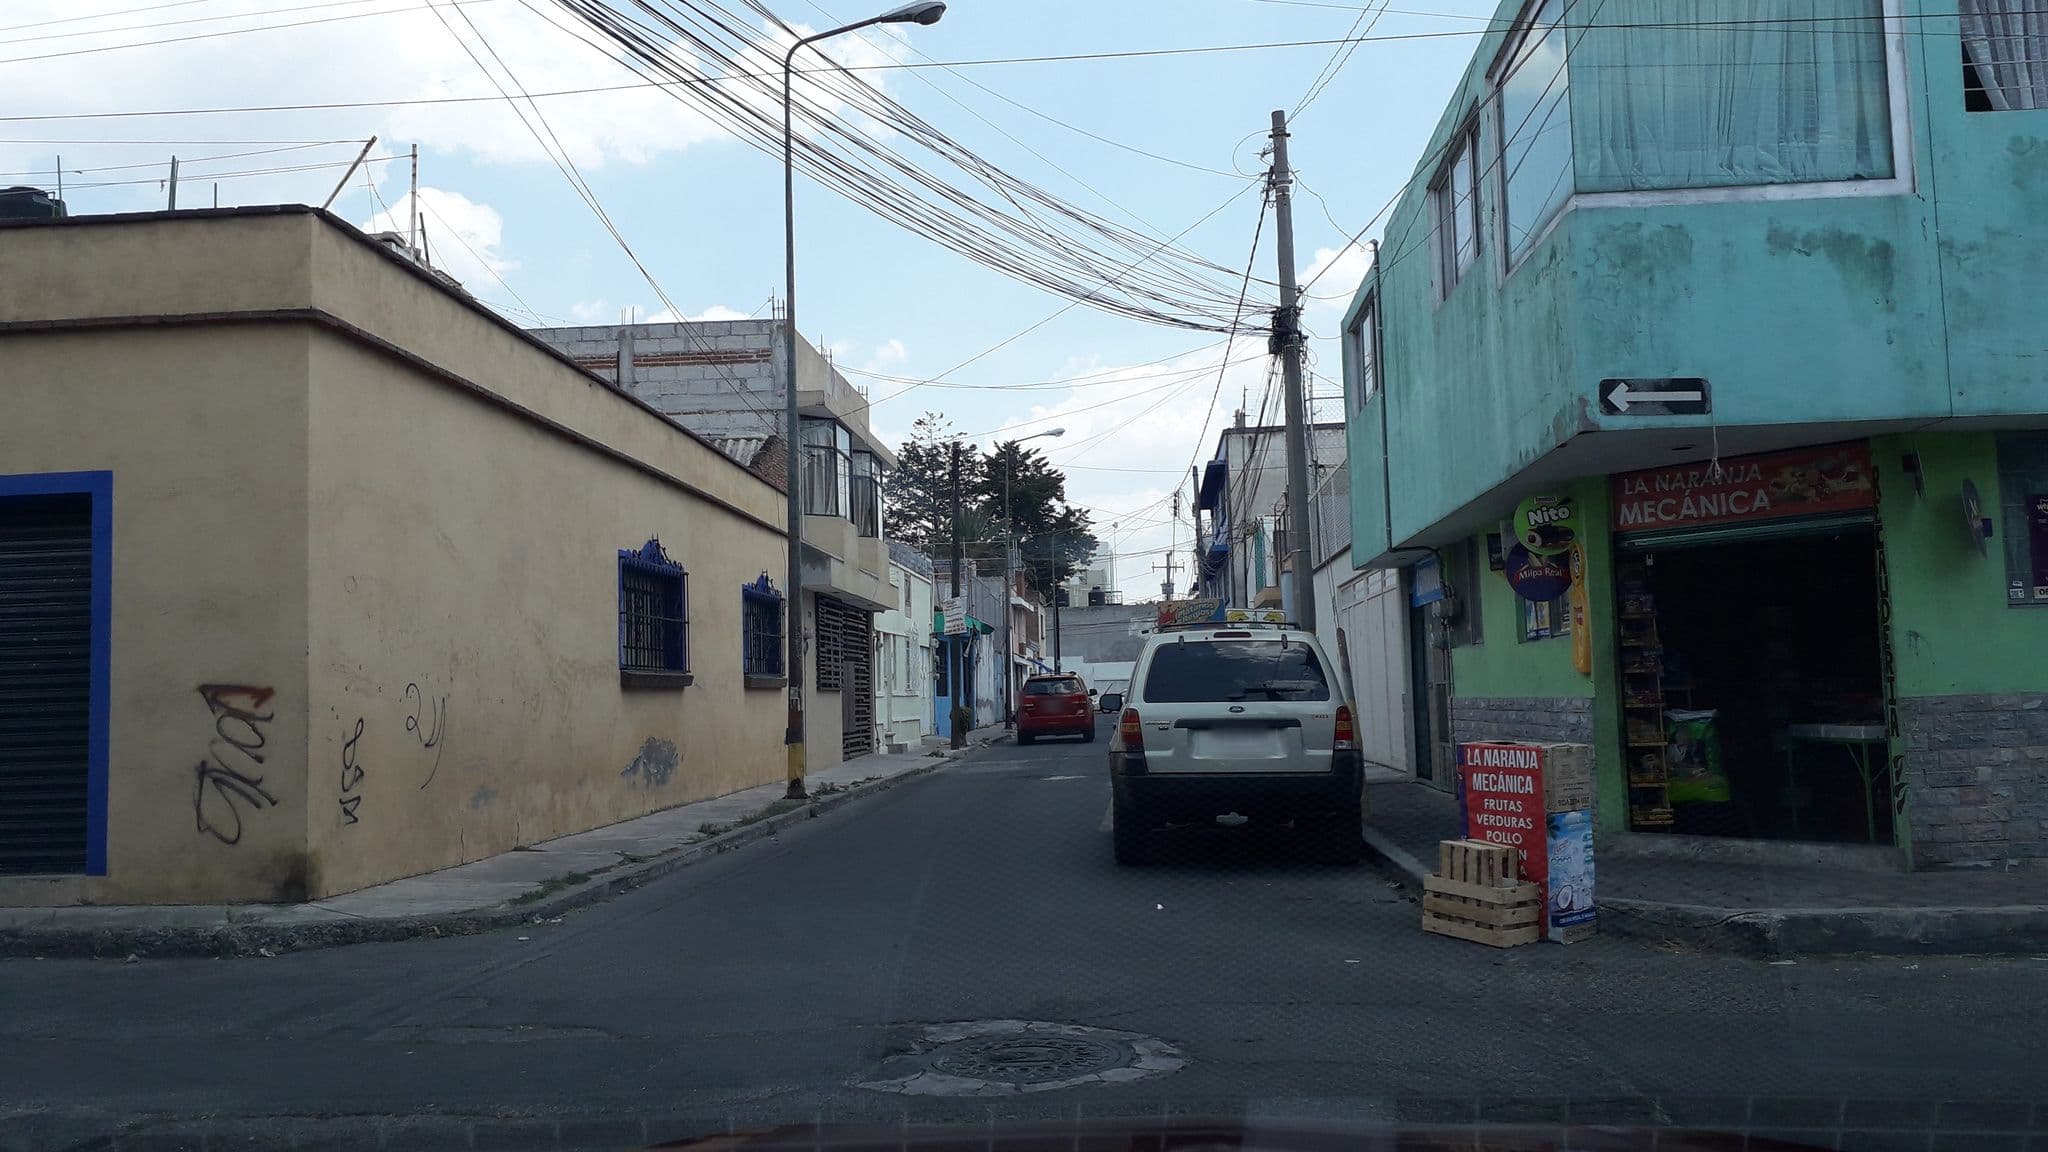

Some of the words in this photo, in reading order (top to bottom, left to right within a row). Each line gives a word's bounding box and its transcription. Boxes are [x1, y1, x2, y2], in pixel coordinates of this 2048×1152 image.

[1624, 477, 1649, 496] LA
[1656, 463, 1762, 493] NARANJA
[1527, 506, 1571, 527] Nito
[1619, 488, 1772, 526] MECÁNICA
[1518, 568, 1543, 581] Milpa
[1544, 567, 1563, 578] Real
[1467, 748, 1482, 767] LA
[1484, 749, 1539, 770] NARANJA
[1472, 771, 1534, 795] MECÁNICA
[1484, 798, 1523, 813] FRUTAS
[1476, 814, 1533, 830] VERDURAS
[1486, 830, 1523, 845] POLLO
